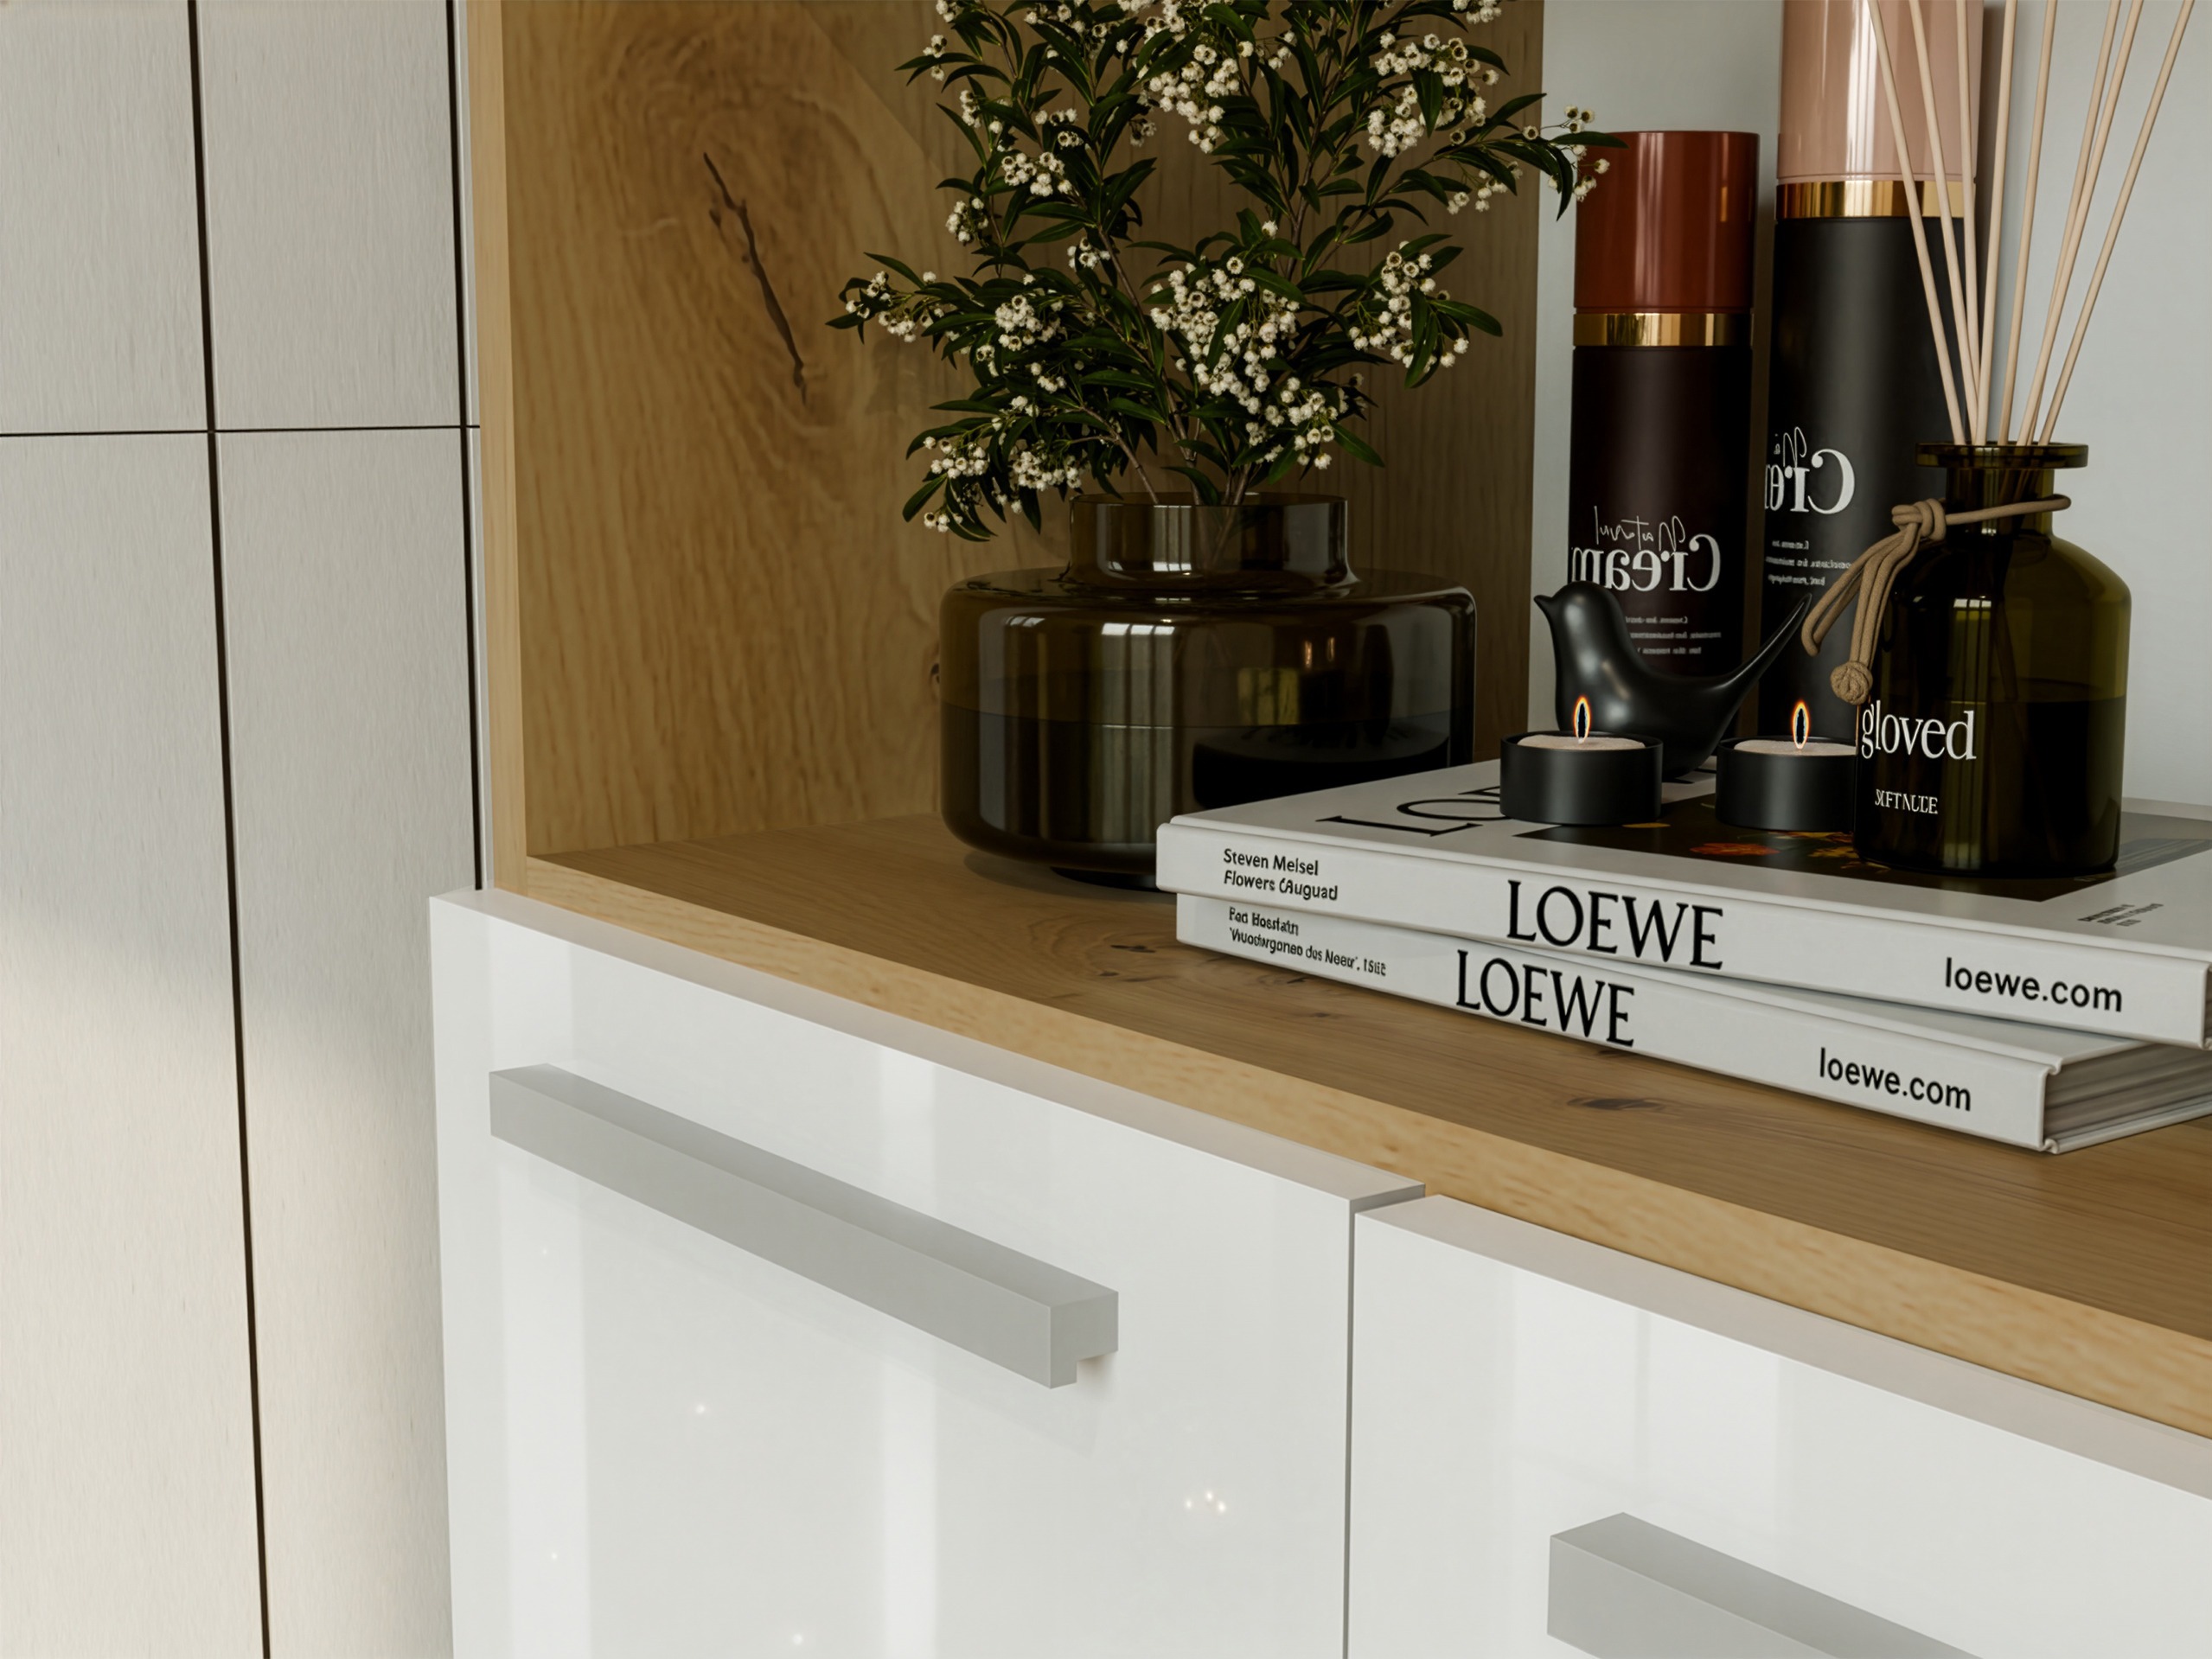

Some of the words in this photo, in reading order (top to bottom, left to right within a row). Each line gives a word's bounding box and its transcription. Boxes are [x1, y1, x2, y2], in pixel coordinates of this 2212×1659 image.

[1861, 699, 1977, 761] gloved
[1223, 848, 1269, 870] Steven
[1224, 870, 1275, 891] Flowers
[1506, 879, 1723, 970] LOEWE
[1455, 949, 1634, 1047] LOEWE
[1946, 957, 2122, 1012] loewe.com
[1819, 1047, 1971, 1112] loewe.com
